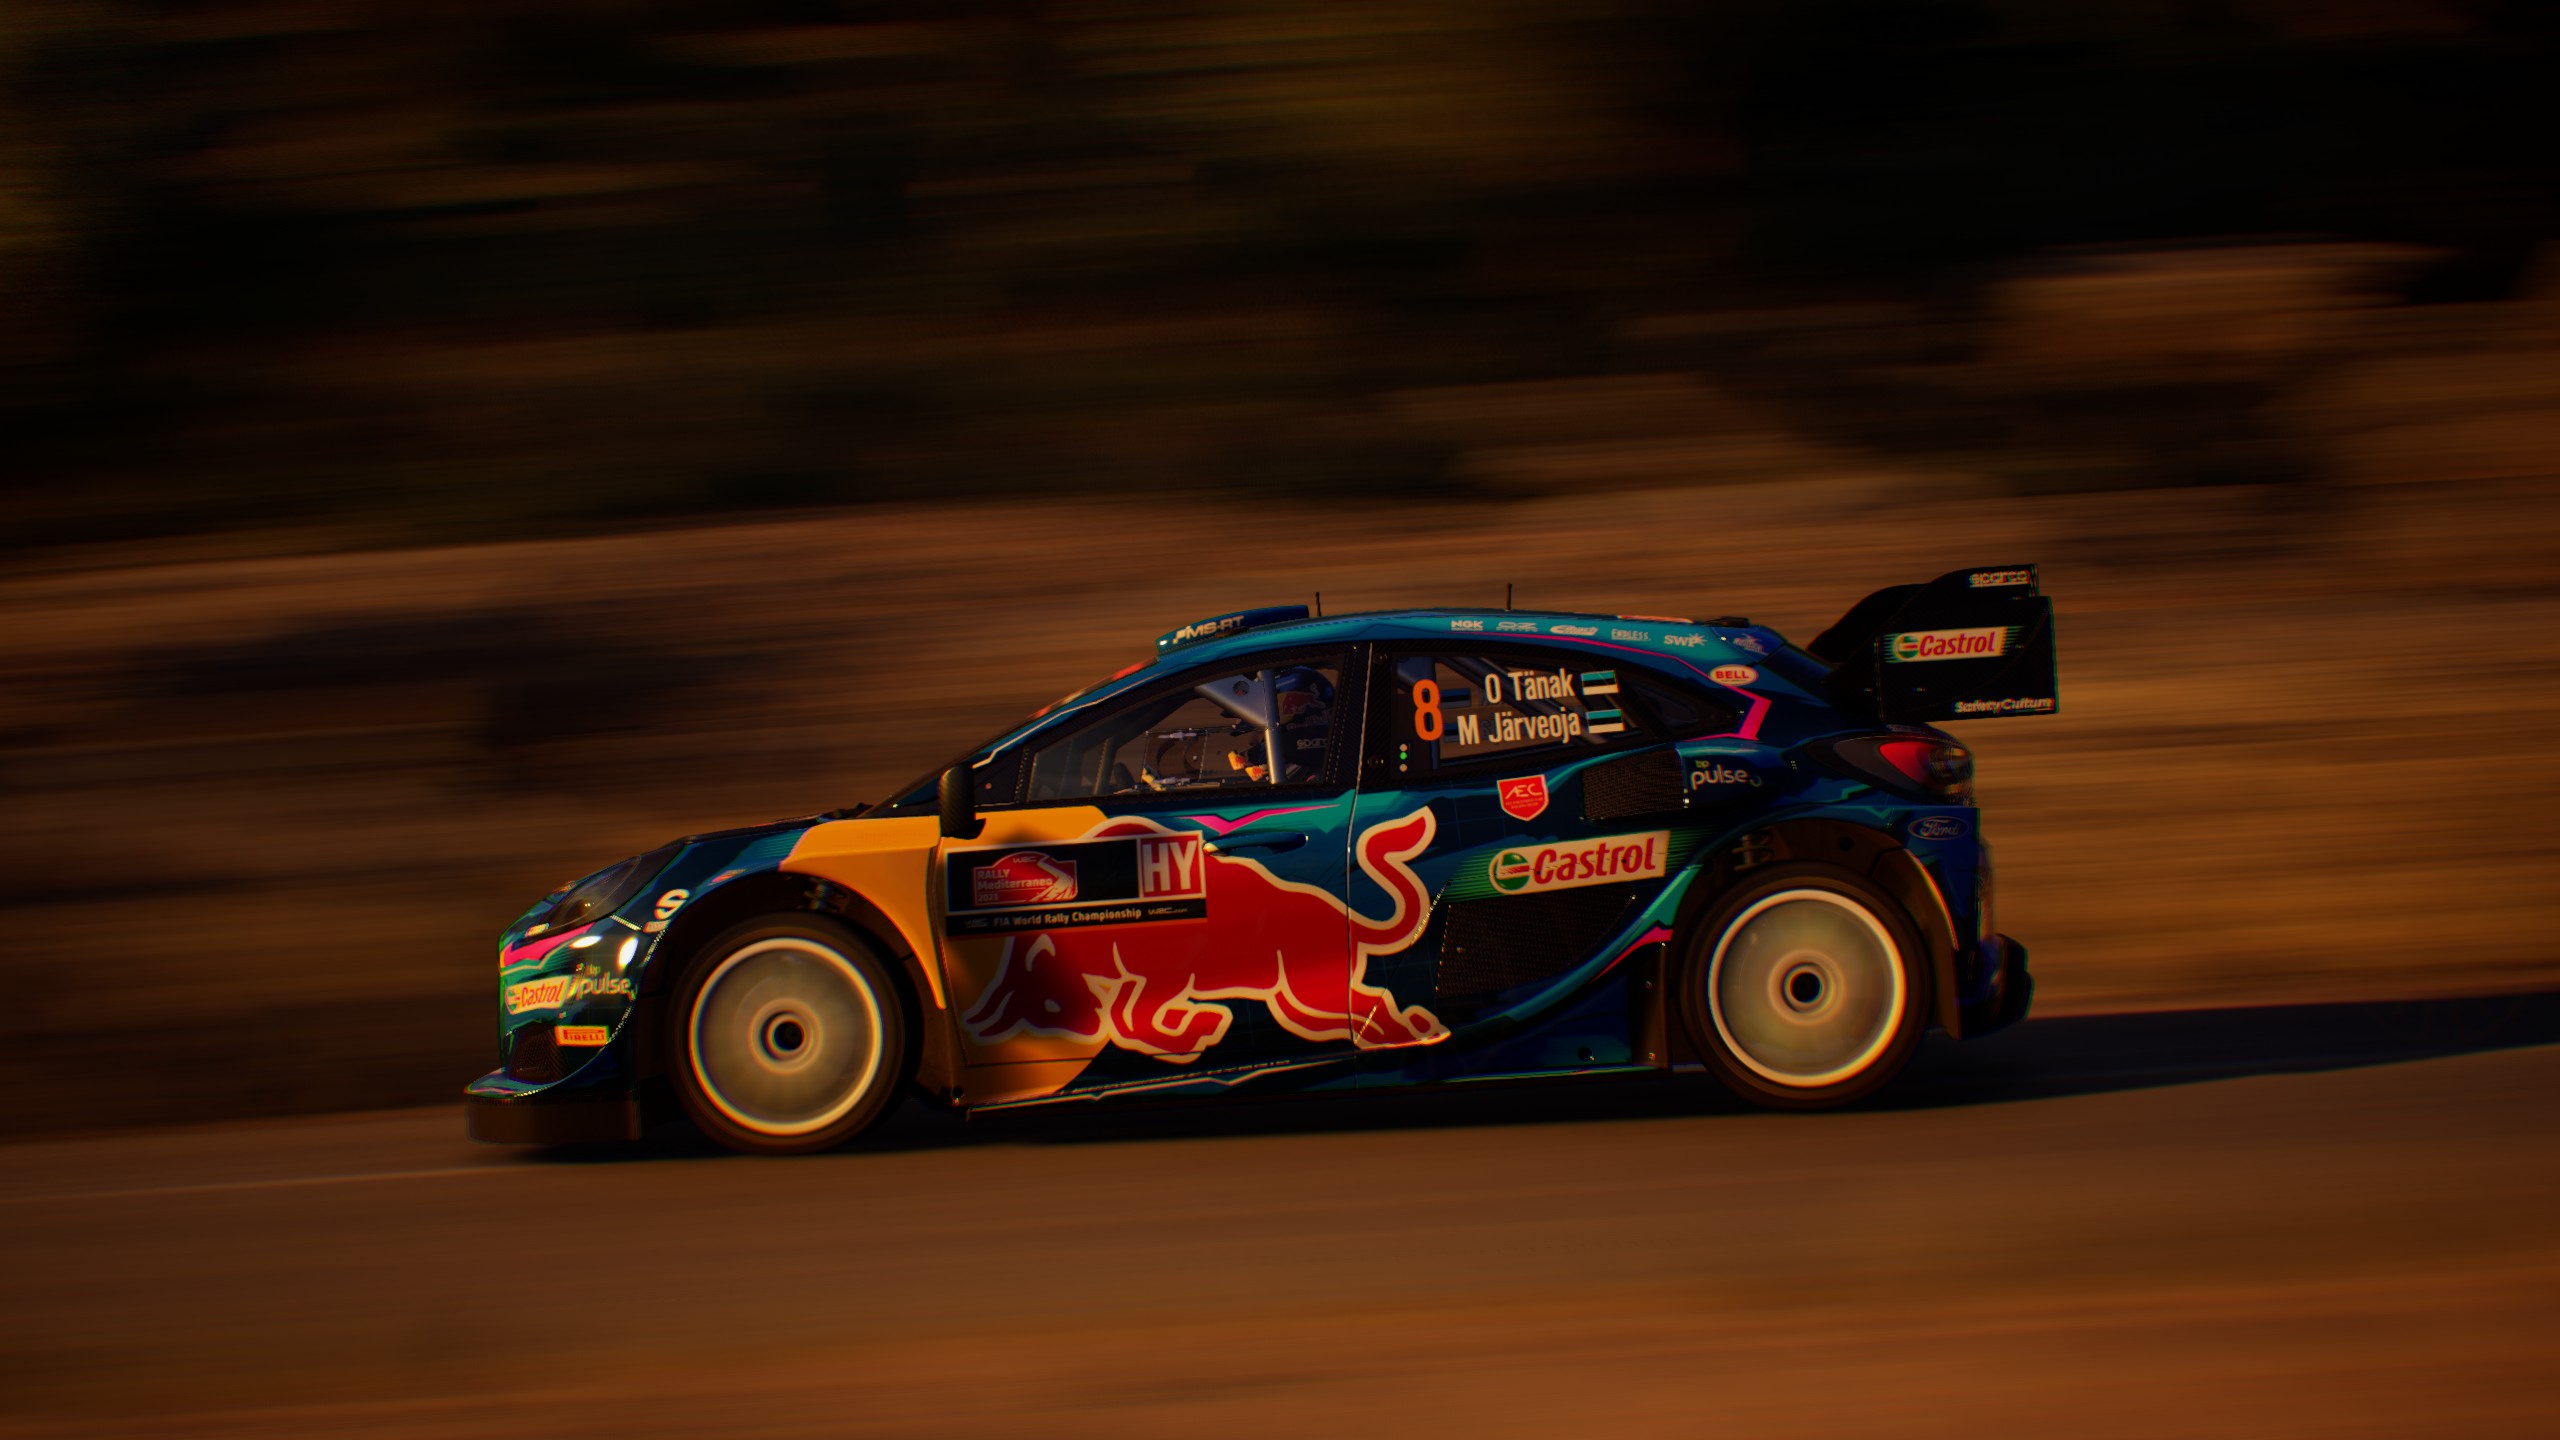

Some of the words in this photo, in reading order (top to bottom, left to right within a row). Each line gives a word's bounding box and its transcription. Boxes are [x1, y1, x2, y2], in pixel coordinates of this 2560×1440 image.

[1451, 620, 1484, 629] NGK
[1920, 631, 1996, 656] Castrol
[1484, 673, 1501, 704] O
[1507, 667, 1575, 702] Tänak
[1716, 671, 1749, 679] BELL
[1412, 679, 1444, 741] 8
[1457, 714, 1480, 746] M
[1488, 706, 1581, 745] Järveoja
[1690, 763, 1748, 791] pulse
[977, 868, 1010, 880] RALLY
[1142, 840, 1198, 893] HY
[1533, 838, 1657, 885] Castrol
[977, 877, 1054, 891] Mediterraneo
[993, 916, 1011, 928] FIA
[1013, 913, 1042, 927] World
[1043, 912, 1070, 925] Rally
[1072, 908, 1142, 922] Championship
[521, 980, 565, 1007] Castrol
[563, 1029, 605, 1041] PIRELLI
